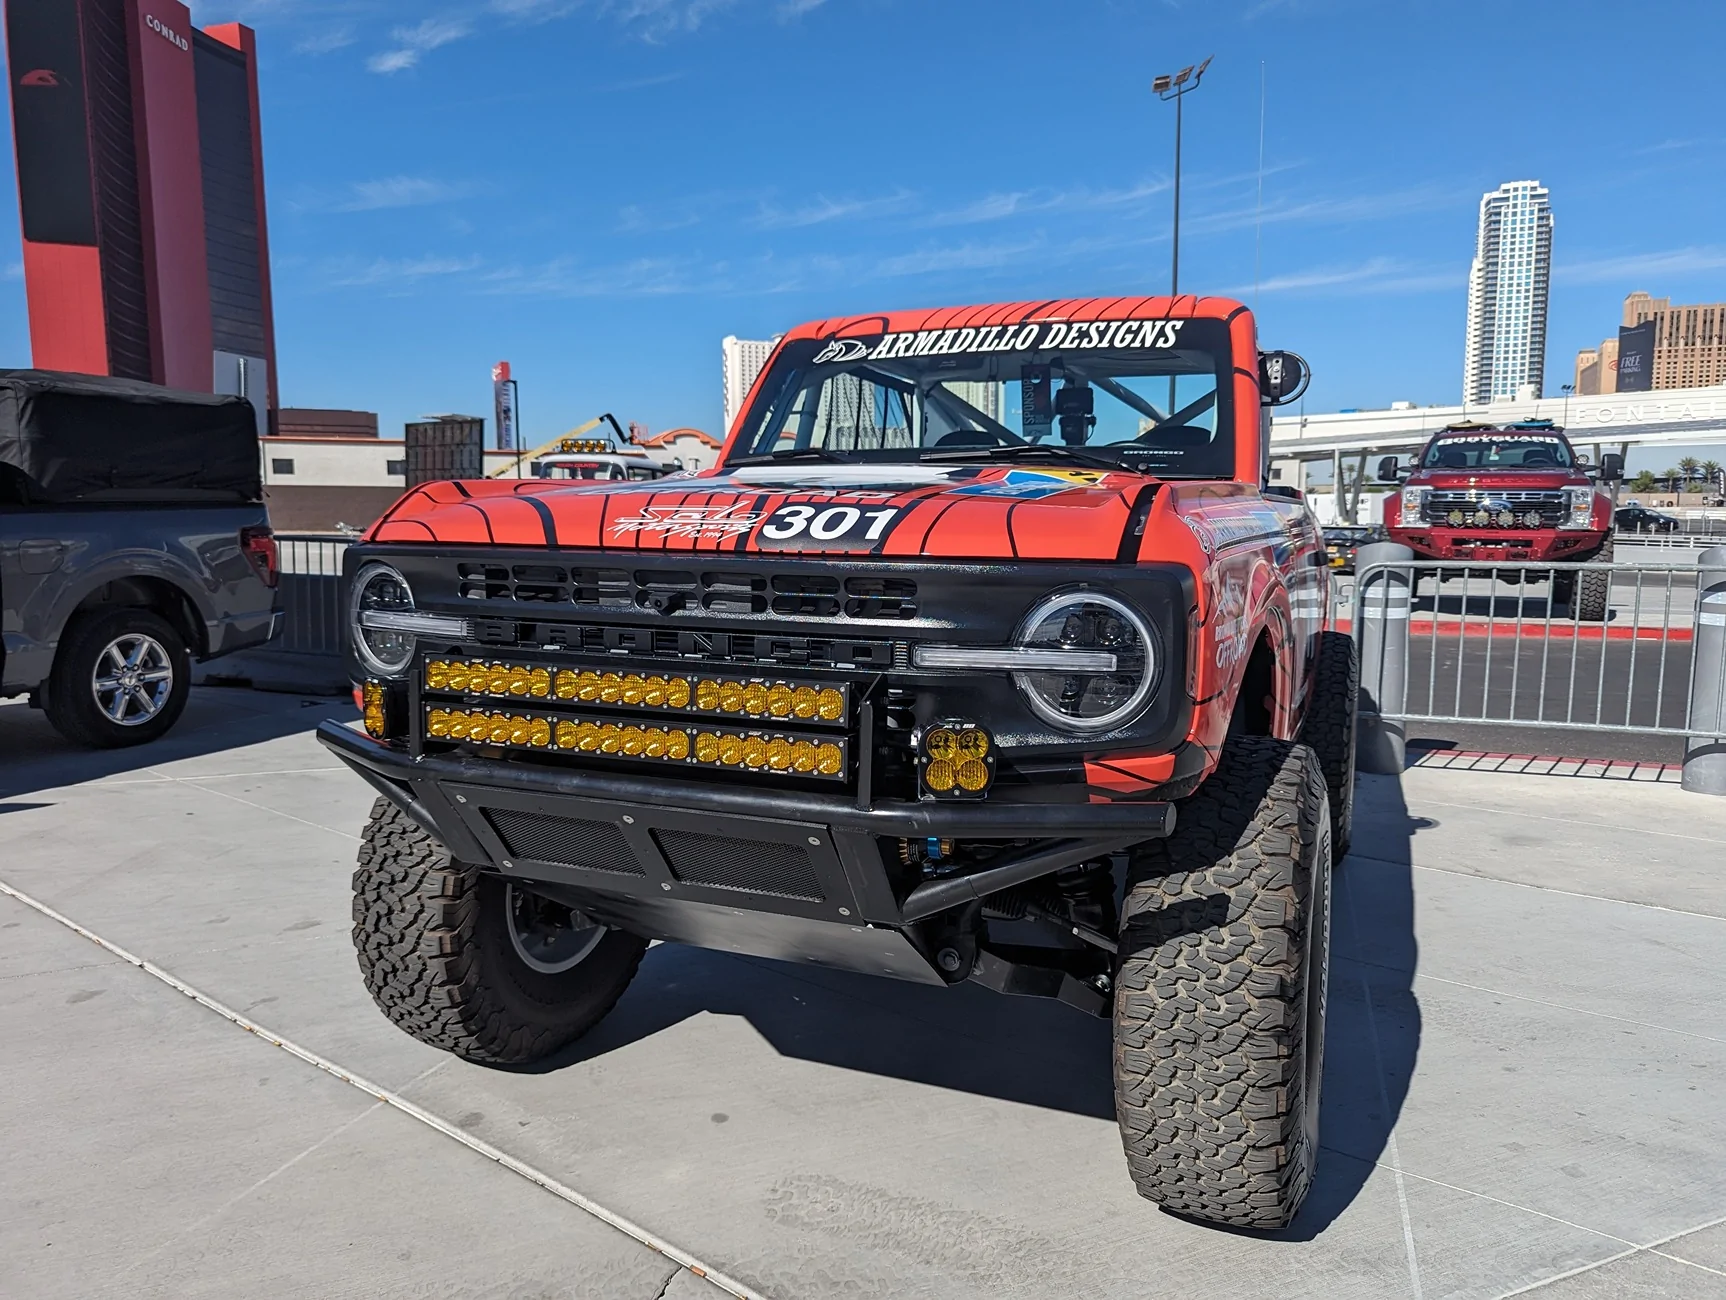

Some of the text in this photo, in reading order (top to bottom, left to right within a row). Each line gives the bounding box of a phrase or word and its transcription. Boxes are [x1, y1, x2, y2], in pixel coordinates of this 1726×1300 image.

[146, 14, 188, 51] CONRAD
[868, 320, 1184, 360] ARMADILLO DESIGNS
[1620, 355, 1642, 368] FREE
[1023, 378, 1035, 424] SPONSOR
[1437, 435, 1559, 446] BODYGUARD
[762, 505, 899, 540] 301
[473, 619, 892, 666] BRONCO
